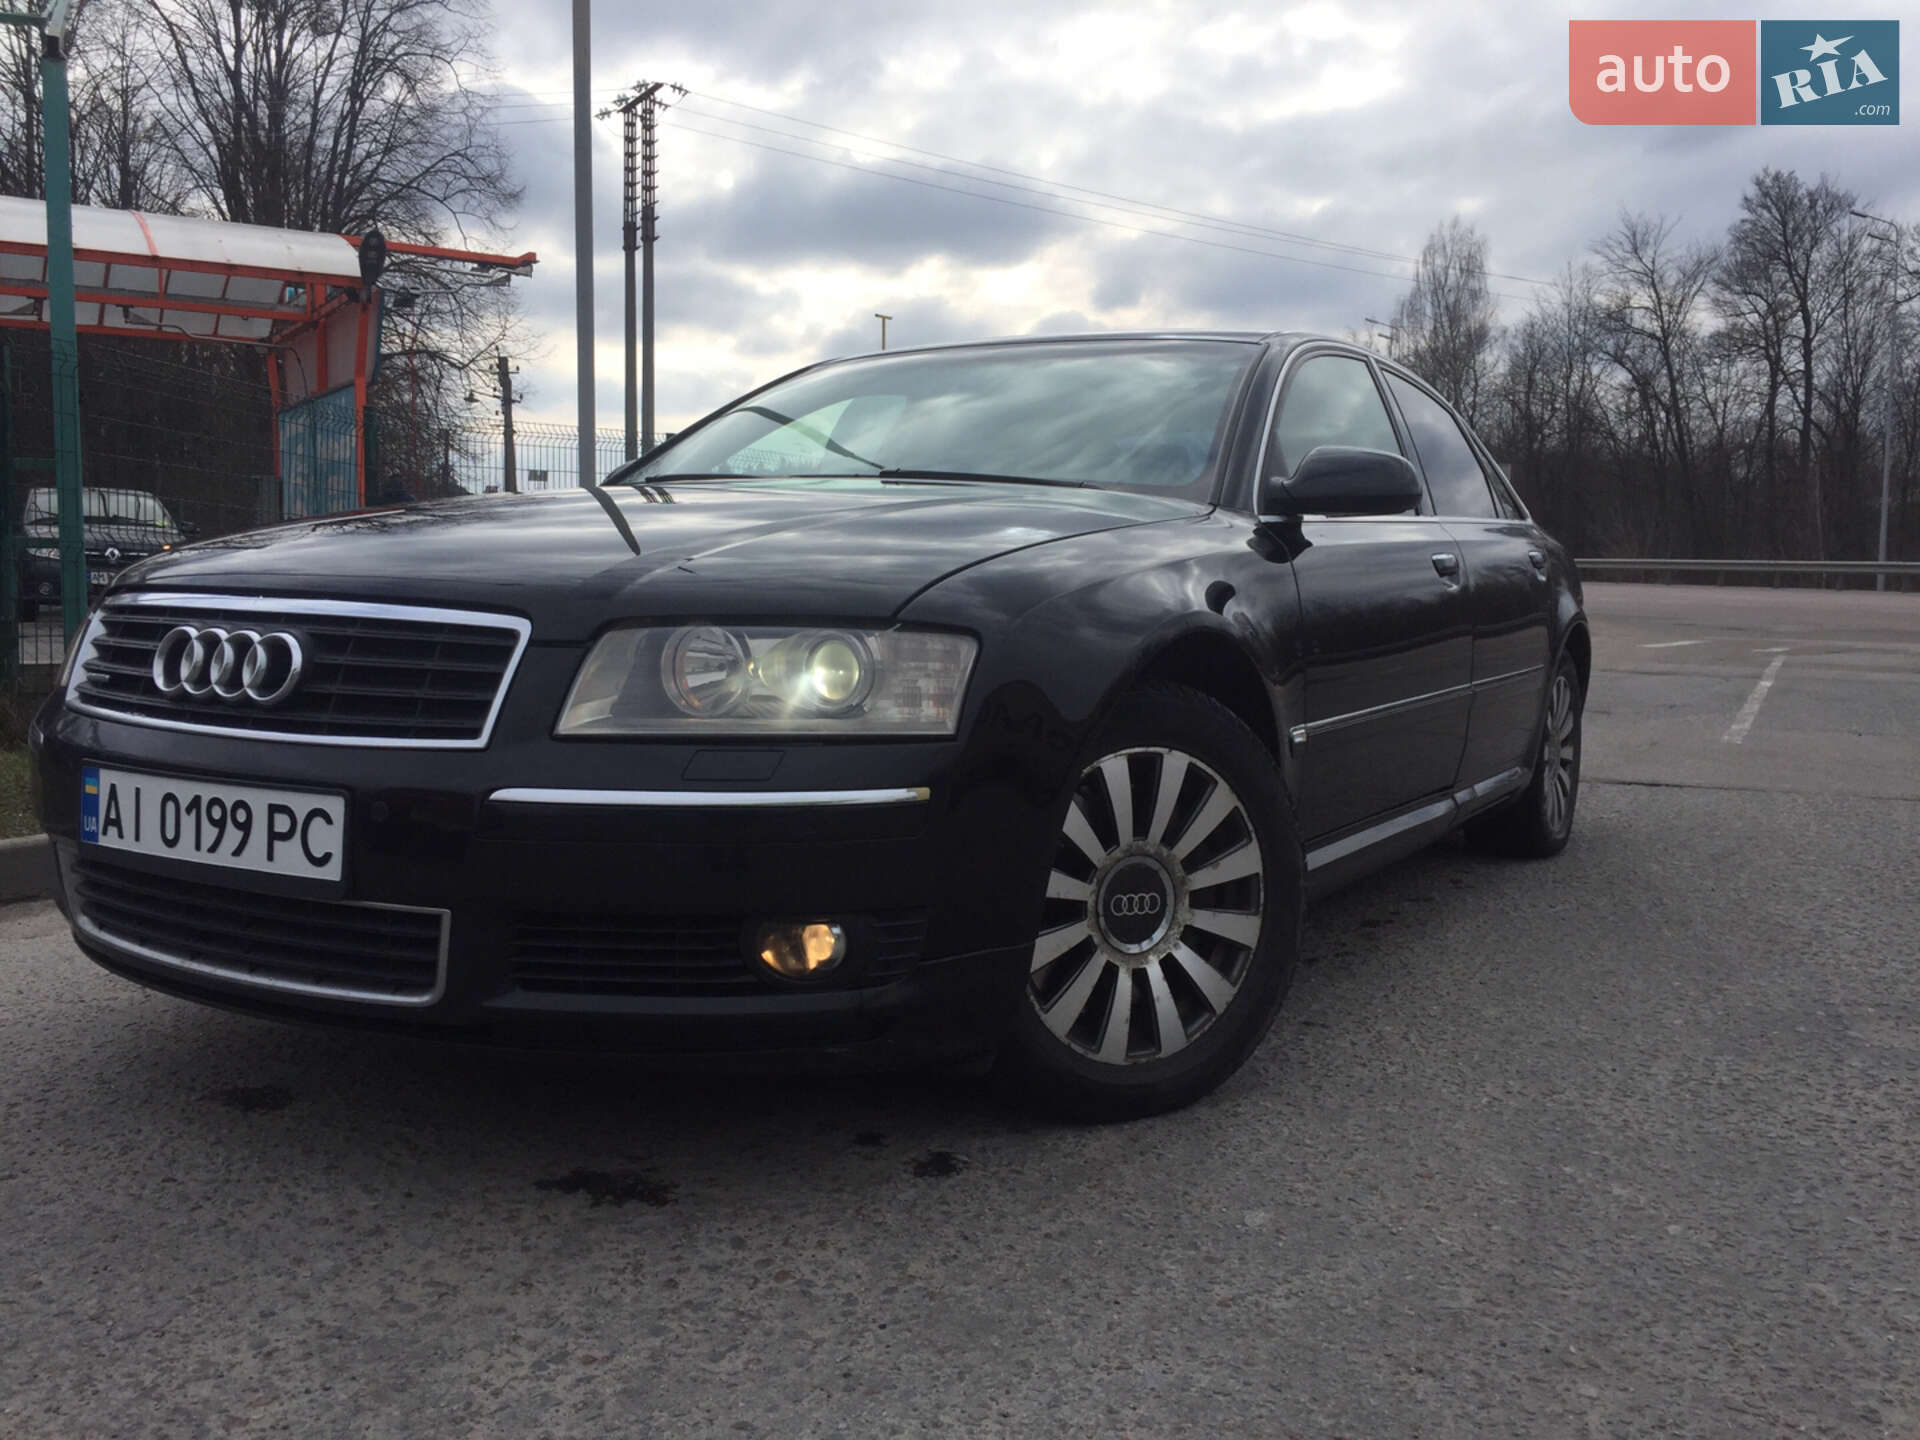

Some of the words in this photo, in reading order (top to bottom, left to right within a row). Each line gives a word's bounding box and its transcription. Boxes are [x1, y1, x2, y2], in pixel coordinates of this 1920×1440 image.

[83, 815, 98, 832] UA
[101, 782, 142, 843] AI
[159, 791, 254, 858] 0199
[266, 803, 334, 868] PC
